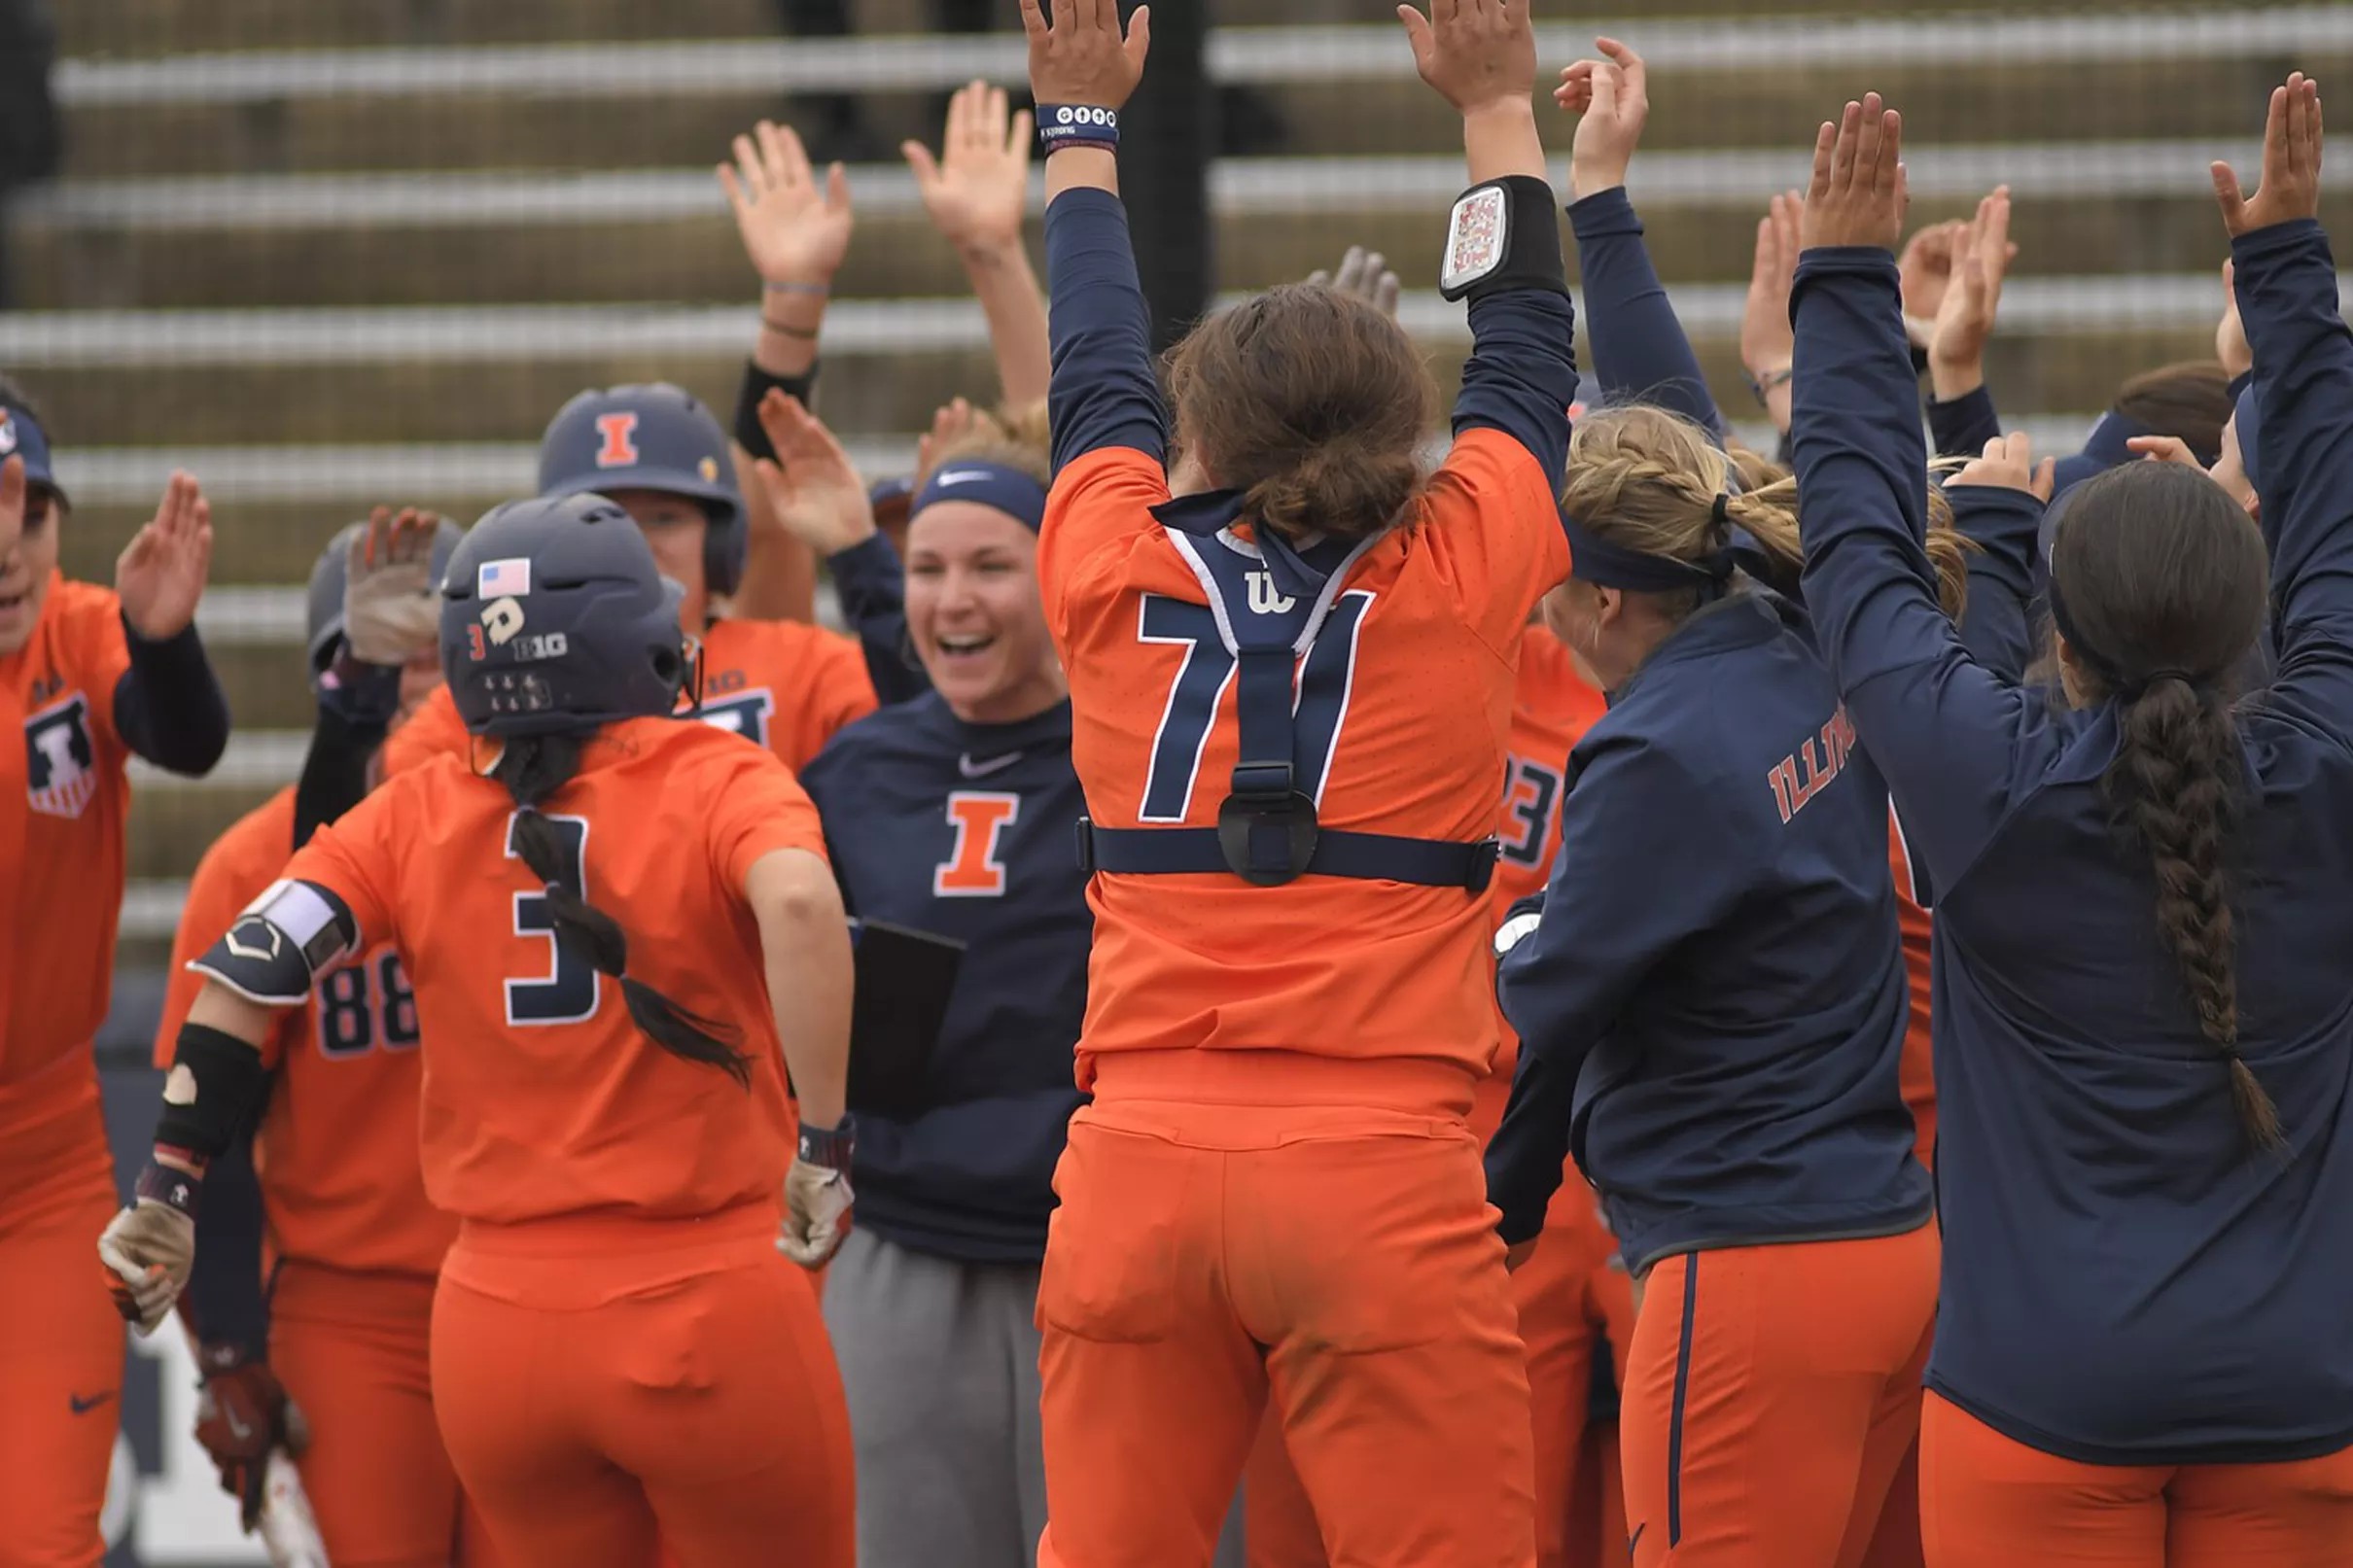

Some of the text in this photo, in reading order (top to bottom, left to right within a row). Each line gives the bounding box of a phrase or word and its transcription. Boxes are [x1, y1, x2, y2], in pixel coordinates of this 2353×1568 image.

[596, 413, 637, 467] I
[467, 623, 486, 661] 3
[933, 792, 1020, 896] I
[504, 812, 601, 1028] 3
[317, 947, 421, 1063] 88
